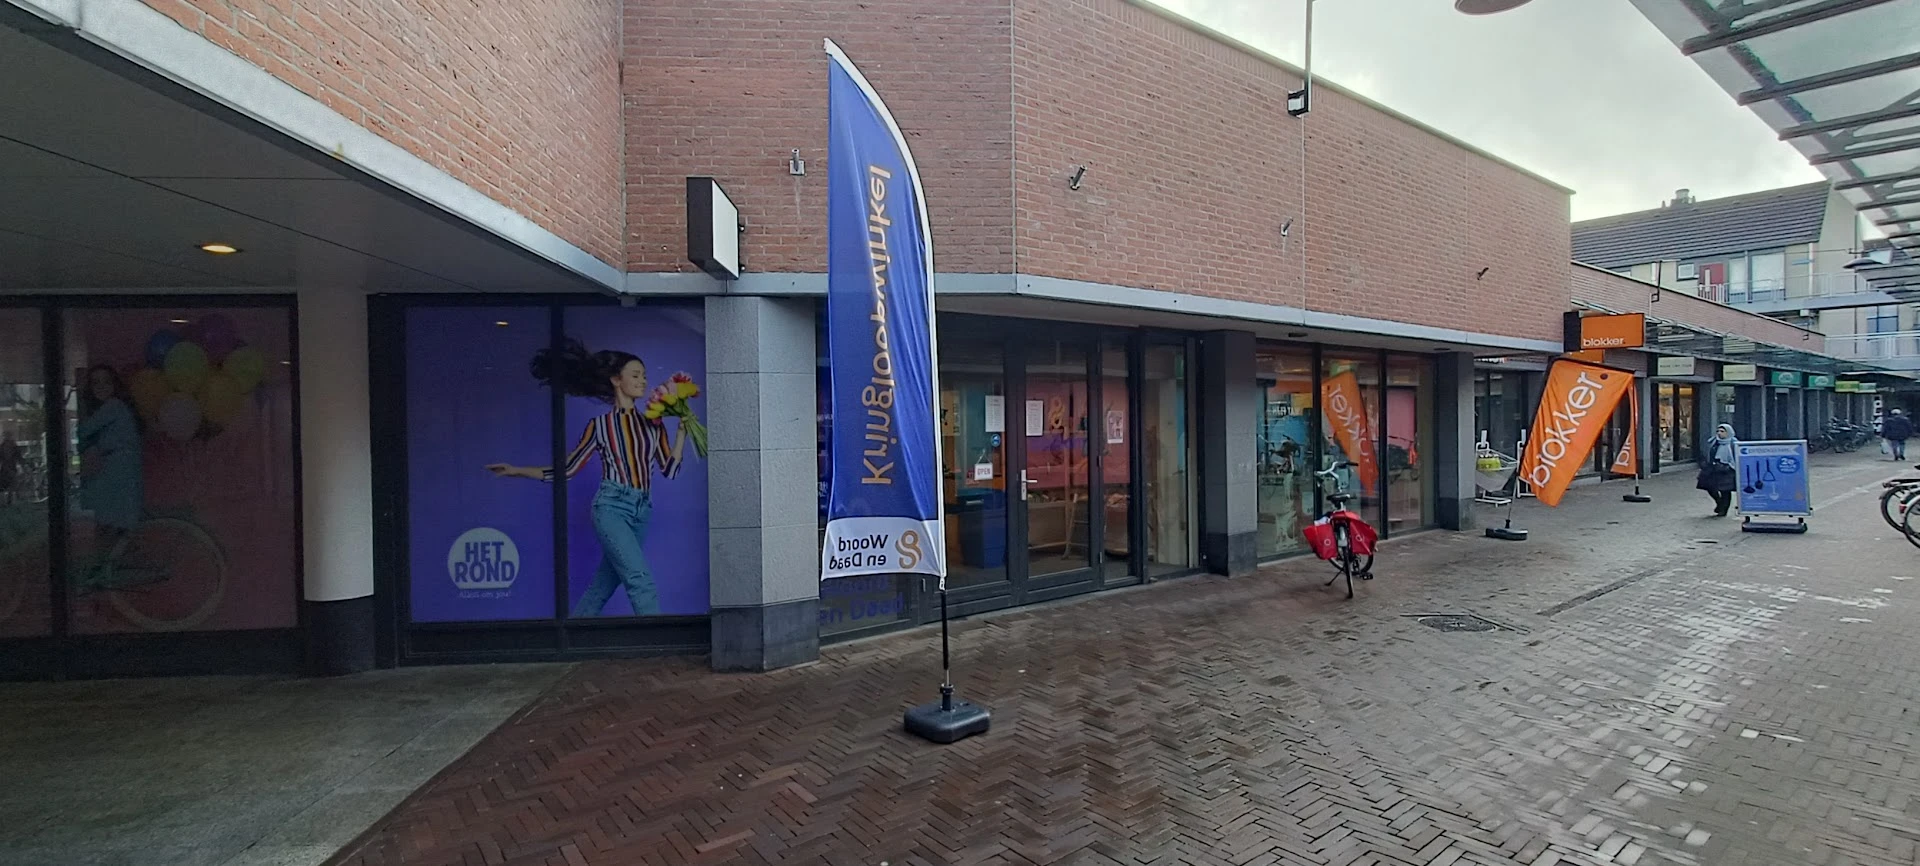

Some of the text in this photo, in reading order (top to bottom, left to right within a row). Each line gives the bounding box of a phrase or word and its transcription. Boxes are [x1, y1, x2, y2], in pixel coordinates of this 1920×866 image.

[1583, 337, 1624, 346] blokker
[1529, 371, 1603, 488] blokker
[464, 541, 504, 562] HET
[454, 561, 515, 582] ROND
